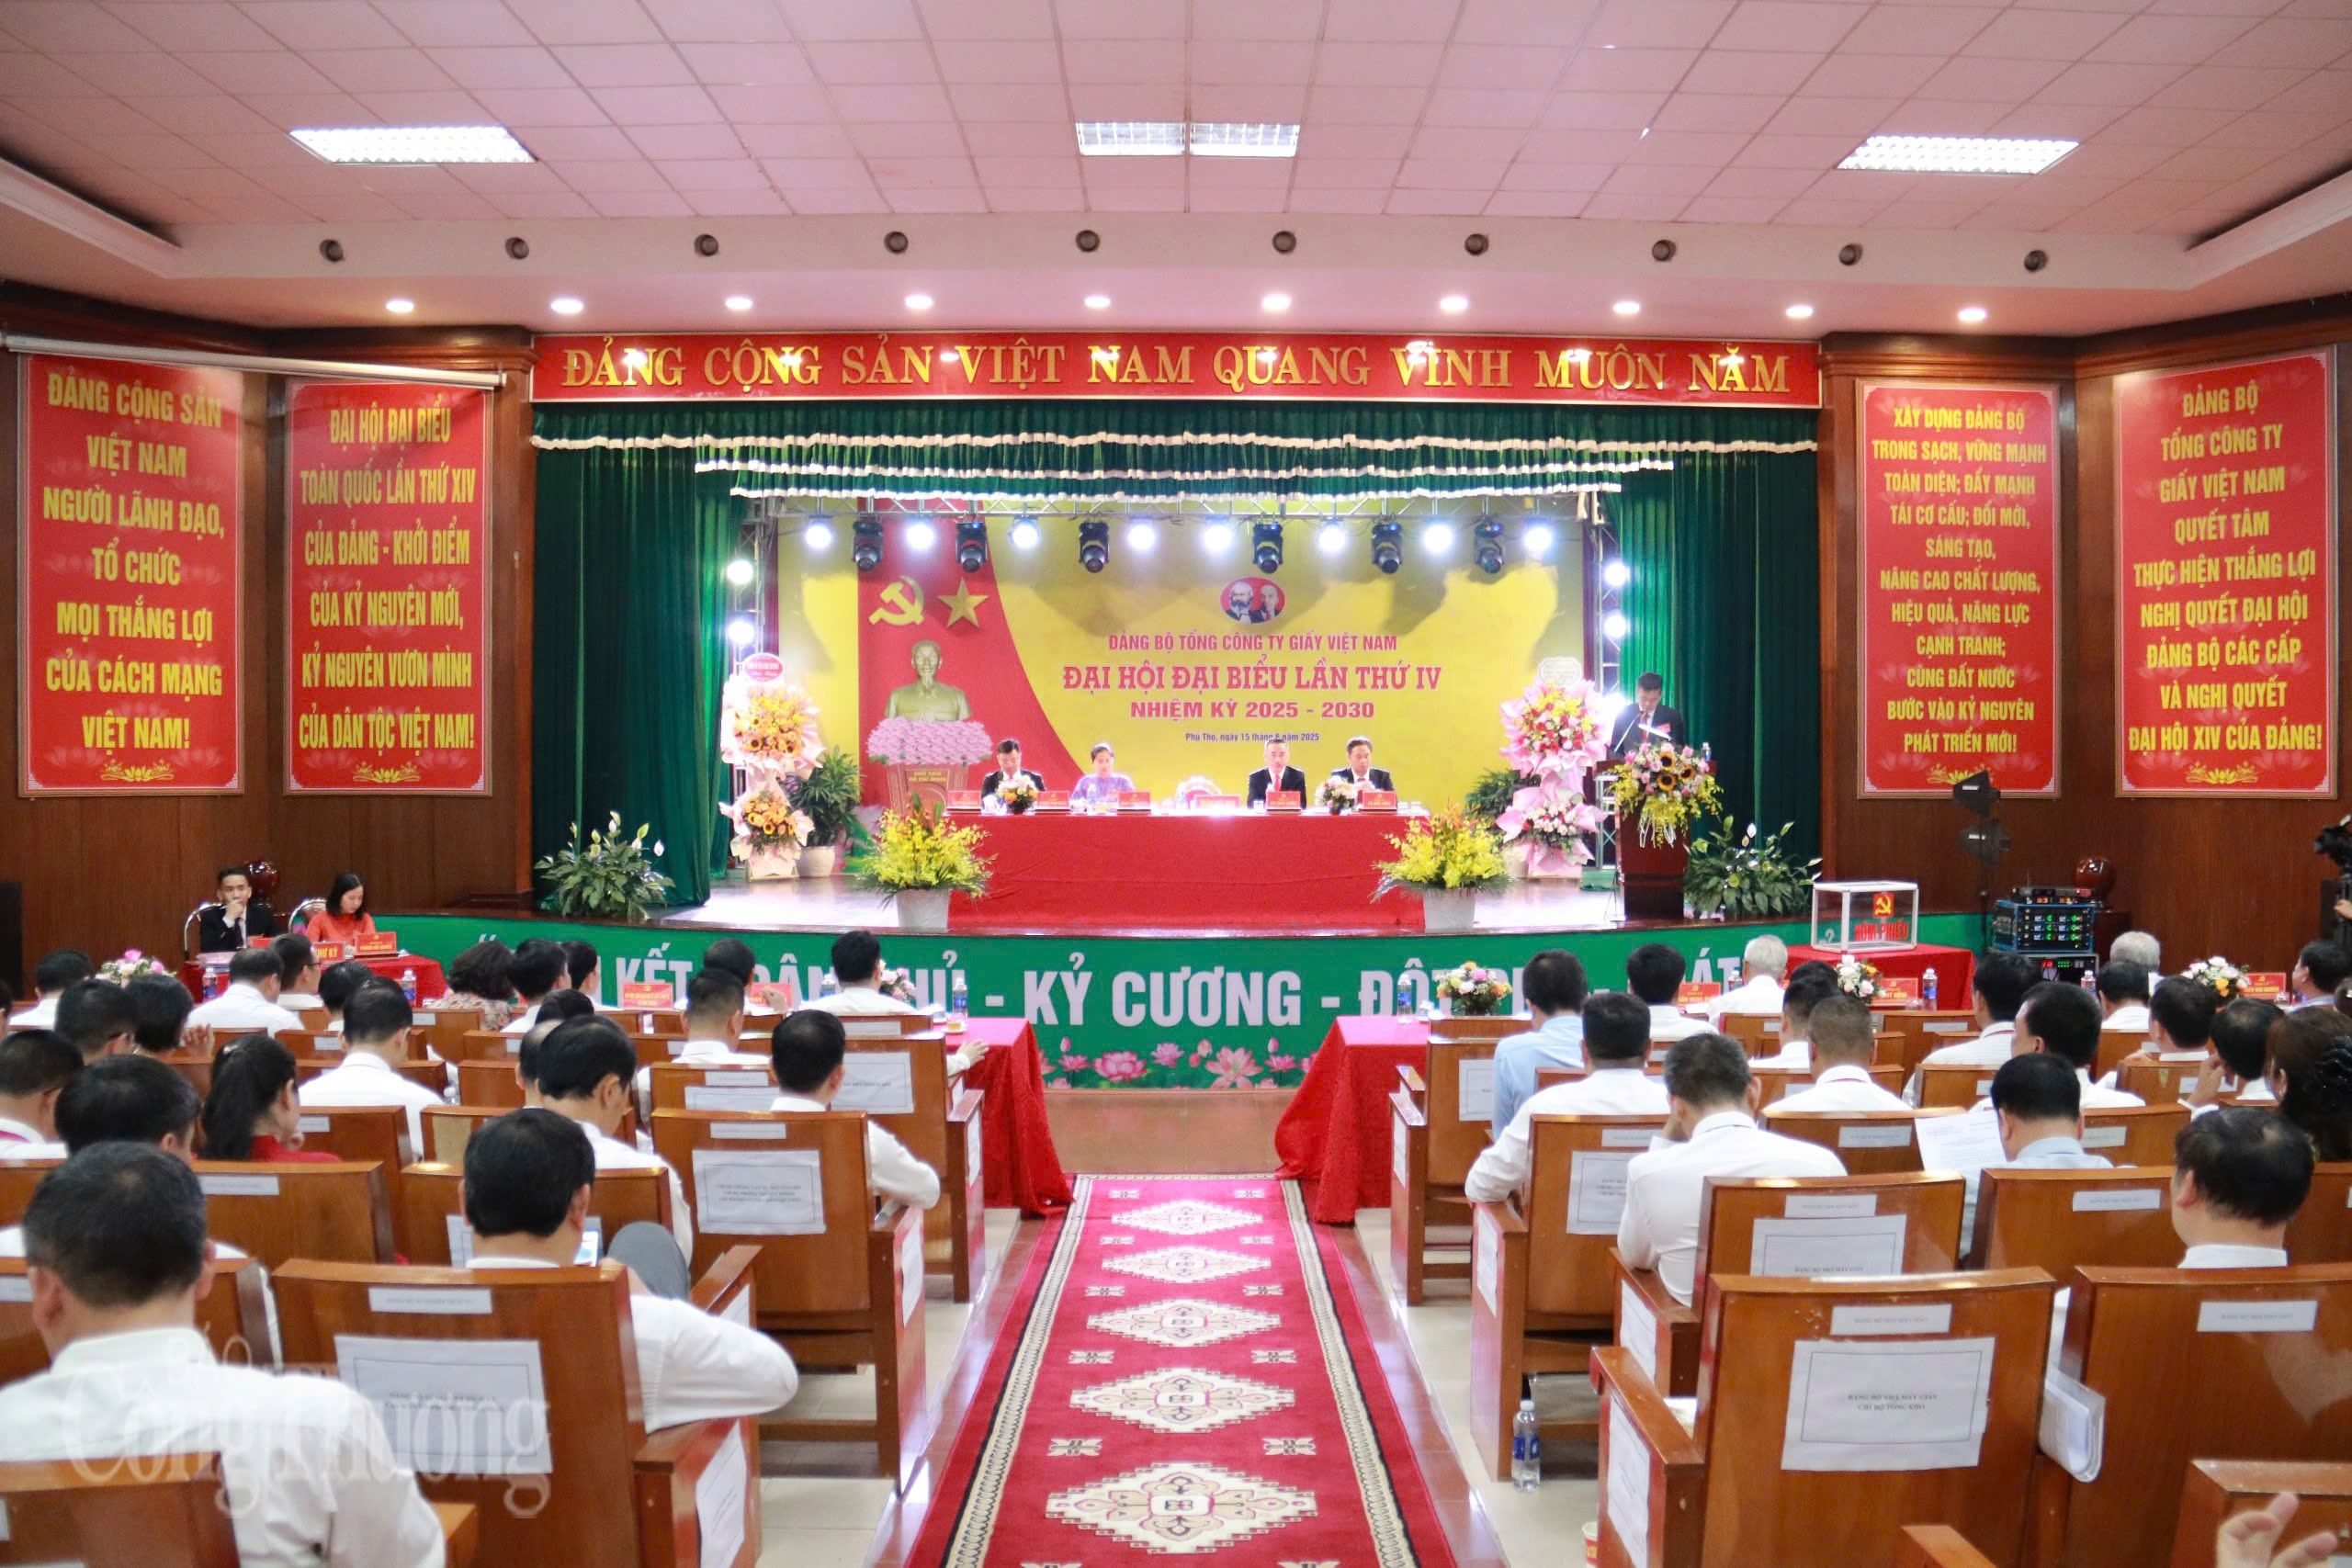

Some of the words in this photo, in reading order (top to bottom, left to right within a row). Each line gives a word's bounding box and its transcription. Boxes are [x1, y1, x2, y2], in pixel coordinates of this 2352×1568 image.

[563, 334, 683, 387] ĐẢNG
[706, 338, 823, 391] CỘNG
[841, 333, 934, 385] SẢN
[952, 338, 1067, 389] VIỆT
[1088, 344, 1193, 384] NAM
[1212, 344, 1371, 392] QUANG
[1391, 345, 1514, 388] VINH
[1536, 343, 1665, 389] MUÔN
[1687, 345, 1790, 393] NĂM
[47, 367, 109, 412] ĐẢNG
[116, 382, 175, 423] CỘNG
[179, 383, 221, 426] SẢN
[2183, 384, 2231, 419] ĐẢNG
[2233, 379, 2259, 414] BỘ
[330, 406, 355, 450] ĐẠI
[358, 401, 384, 450] HỘI
[386, 406, 414, 448] ĐẠI
[416, 393, 451, 442] BIỂU
[2161, 425, 2205, 463] TỔNG
[2209, 426, 2257, 456] CÔNG
[2261, 423, 2283, 450] TY
[87, 434, 133, 475] VIỆT
[137, 441, 187, 477] NAM
[300, 462, 340, 506] TOÀN
[343, 458, 382, 509] QUỐC
[386, 456, 416, 504] LẦN
[419, 464, 450, 503] THỨ
[450, 468, 476, 502] XIV
[2158, 469, 2198, 502] GIẤY
[2202, 466, 2240, 502] VIỆT
[2243, 466, 2286, 493] NAM
[43, 485, 112, 527] NGƯỜI
[118, 498, 174, 530] LÃNH
[177, 501, 225, 540] ĐẠO,
[2175, 507, 2226, 545] QUYẾT
[2231, 508, 2271, 537] TÂM
[91, 536, 120, 581] TỔ
[124, 547, 181, 587] CHỨC
[303, 520, 335, 566] CỦA
[337, 521, 379, 566] ĐẢNG
[392, 519, 428, 567] KHỞI
[431, 517, 470, 566] ĐIỂM
[2133, 558, 2177, 590] THỰC
[2178, 554, 2221, 589] HIỆN
[2223, 547, 2283, 581] THẮNG
[2286, 547, 2316, 581] LỢI
[56, 603, 101, 642] MỌI
[105, 595, 176, 639] THẮNG
[181, 607, 213, 647] LỢI
[309, 582, 341, 628] CỦA
[344, 580, 364, 627] KỶ
[367, 584, 426, 626] NGUYÊN
[430, 584, 463, 629] MỚI,
[2140, 601, 2181, 632] NGHỊ
[2184, 591, 2239, 628] QUYẾT
[2242, 595, 2274, 626] ĐẠI
[2277, 589, 2309, 625] HỘI
[301, 641, 322, 688] KỶ
[324, 647, 386, 689] NGUYÊN
[388, 649, 429, 689] VƯƠN
[431, 644, 473, 688] MÌNH
[1063, 665, 1111, 694] ĐẠI
[1117, 660, 1166, 694] HỘI
[1170, 665, 1220, 694] ĐẠI
[1227, 653, 1288, 690] BIỂU
[1295, 656, 1349, 690] LẦN
[1354, 660, 1411, 690] THỨ
[1417, 666, 1442, 690] IV
[2146, 636, 2193, 669] ĐẢNG
[2196, 637, 2221, 673] BỘ
[2223, 637, 2261, 667] CÁC
[2266, 629, 2301, 665] CẤP
[46, 648, 92, 692] CỦA
[97, 656, 155, 695] CÁCH
[161, 661, 223, 703] MẠNG
[2160, 680, 2183, 710] VÀ
[2185, 682, 2229, 712] NGHỊ
[2231, 675, 2288, 710] QUYẾT
[299, 703, 331, 750] CỦA
[332, 706, 364, 750] DÂN
[367, 706, 396, 756] TỘC
[397, 705, 431, 757] VIỆT
[434, 713, 476, 749] NAM!
[1131, 697, 1204, 720] NHIỆM
[1246, 702, 1299, 718] 2025
[1322, 702, 1374, 718] 2030
[82, 709, 129, 756] VIỆT
[133, 716, 191, 749] NAM!
[2128, 727, 2156, 755] ĐẠI
[2159, 721, 2189, 755] HỘI
[2194, 724, 2222, 750] XIV
[2224, 716, 2262, 750] CỦA
[2264, 717, 2324, 750] ĐẢNG!
[1023, 952, 1092, 1025] KỶ
[1111, 965, 1302, 1027] CƯƠNG
